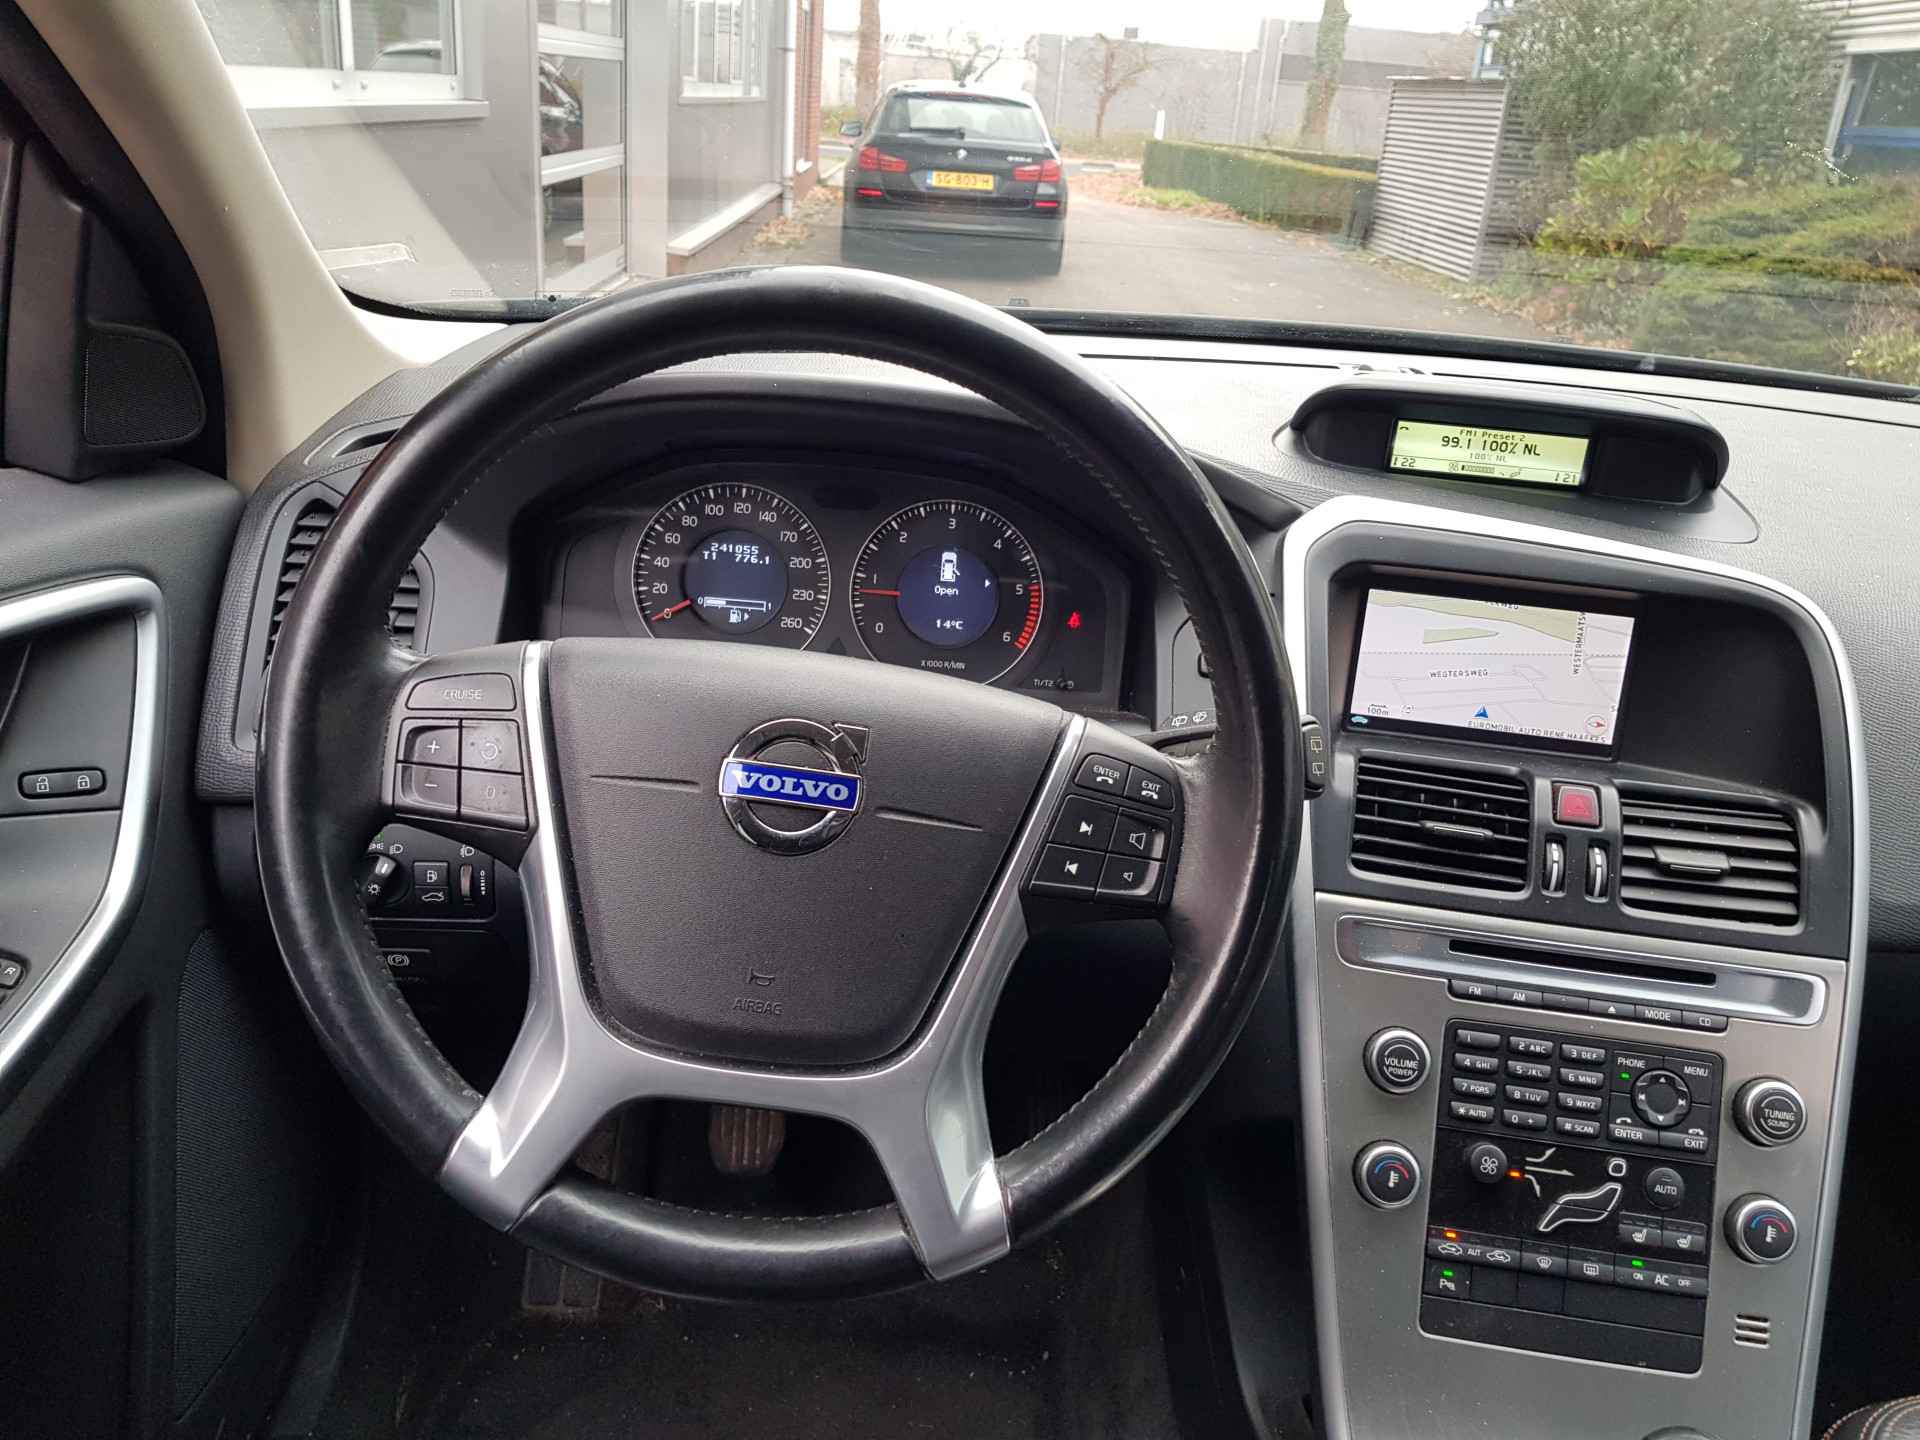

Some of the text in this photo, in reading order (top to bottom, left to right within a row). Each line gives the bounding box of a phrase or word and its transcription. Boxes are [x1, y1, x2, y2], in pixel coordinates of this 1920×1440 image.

[1482, 431, 1515, 441] Preset
[1520, 434, 1526, 442] 2
[1441, 436, 1541, 456] 99.1 100% NL
[705, 504, 724, 516] 100
[734, 502, 751, 514] 120
[681, 516, 698, 527] 80
[759, 511, 777, 522] 140
[949, 519, 956, 529] 3
[665, 533, 681, 544] 60
[780, 531, 798, 542] 170
[900, 532, 907, 543] 2
[711, 543, 759, 555] 241055
[993, 539, 1002, 550] 4
[653, 557, 670, 568] 40
[703, 551, 769, 565] T1 776.1
[789, 557, 812, 569] 200
[652, 583, 668, 594] 20
[934, 585, 959, 597] Open
[1016, 584, 1023, 595] 5
[792, 589, 814, 601] 230
[780, 617, 802, 629] 260
[875, 622, 884, 633] 0
[936, 619, 964, 630] 14°C
[1003, 632, 1011, 642] 6
[443, 688, 482, 700] CRUISE
[1093, 764, 1120, 779] ENTER
[732, 769, 849, 801] VOLVO
[1142, 780, 1161, 792] EXIT
[1469, 986, 1481, 996] FM
[1513, 992, 1525, 1001] AM
[733, 997, 784, 1015] AIRBAG
[1645, 1009, 1671, 1021] MODE
[1699, 1016, 1712, 1026] CD
[1519, 1042, 1547, 1054] 2 ABC
[1571, 1049, 1597, 1059] 3 DEF
[1385, 1057, 1419, 1069] VOLUME
[1464, 1058, 1490, 1069] 4 GHI
[1617, 1057, 1646, 1069] PHONE
[1388, 1066, 1413, 1076] POWER
[1516, 1066, 1543, 1077] 5 JKL
[1684, 1066, 1709, 1077] MENU
[1569, 1074, 1574, 1082] 6
[1462, 1083, 1467, 1091] 7
[1514, 1090, 1541, 1102] 8 TUV
[1567, 1098, 1596, 1109] 9 WXYZ
[1468, 1109, 1488, 1118] AUTO
[1512, 1115, 1518, 1123] 0
[1764, 1108, 1795, 1121] TUNING
[1574, 1125, 1594, 1134] SCAN
[1615, 1129, 1643, 1140] ENTER
[1684, 1138, 1705, 1149] EXIT
[1654, 1184, 1677, 1195] AUTO
[1654, 1274, 1669, 1287] AC
